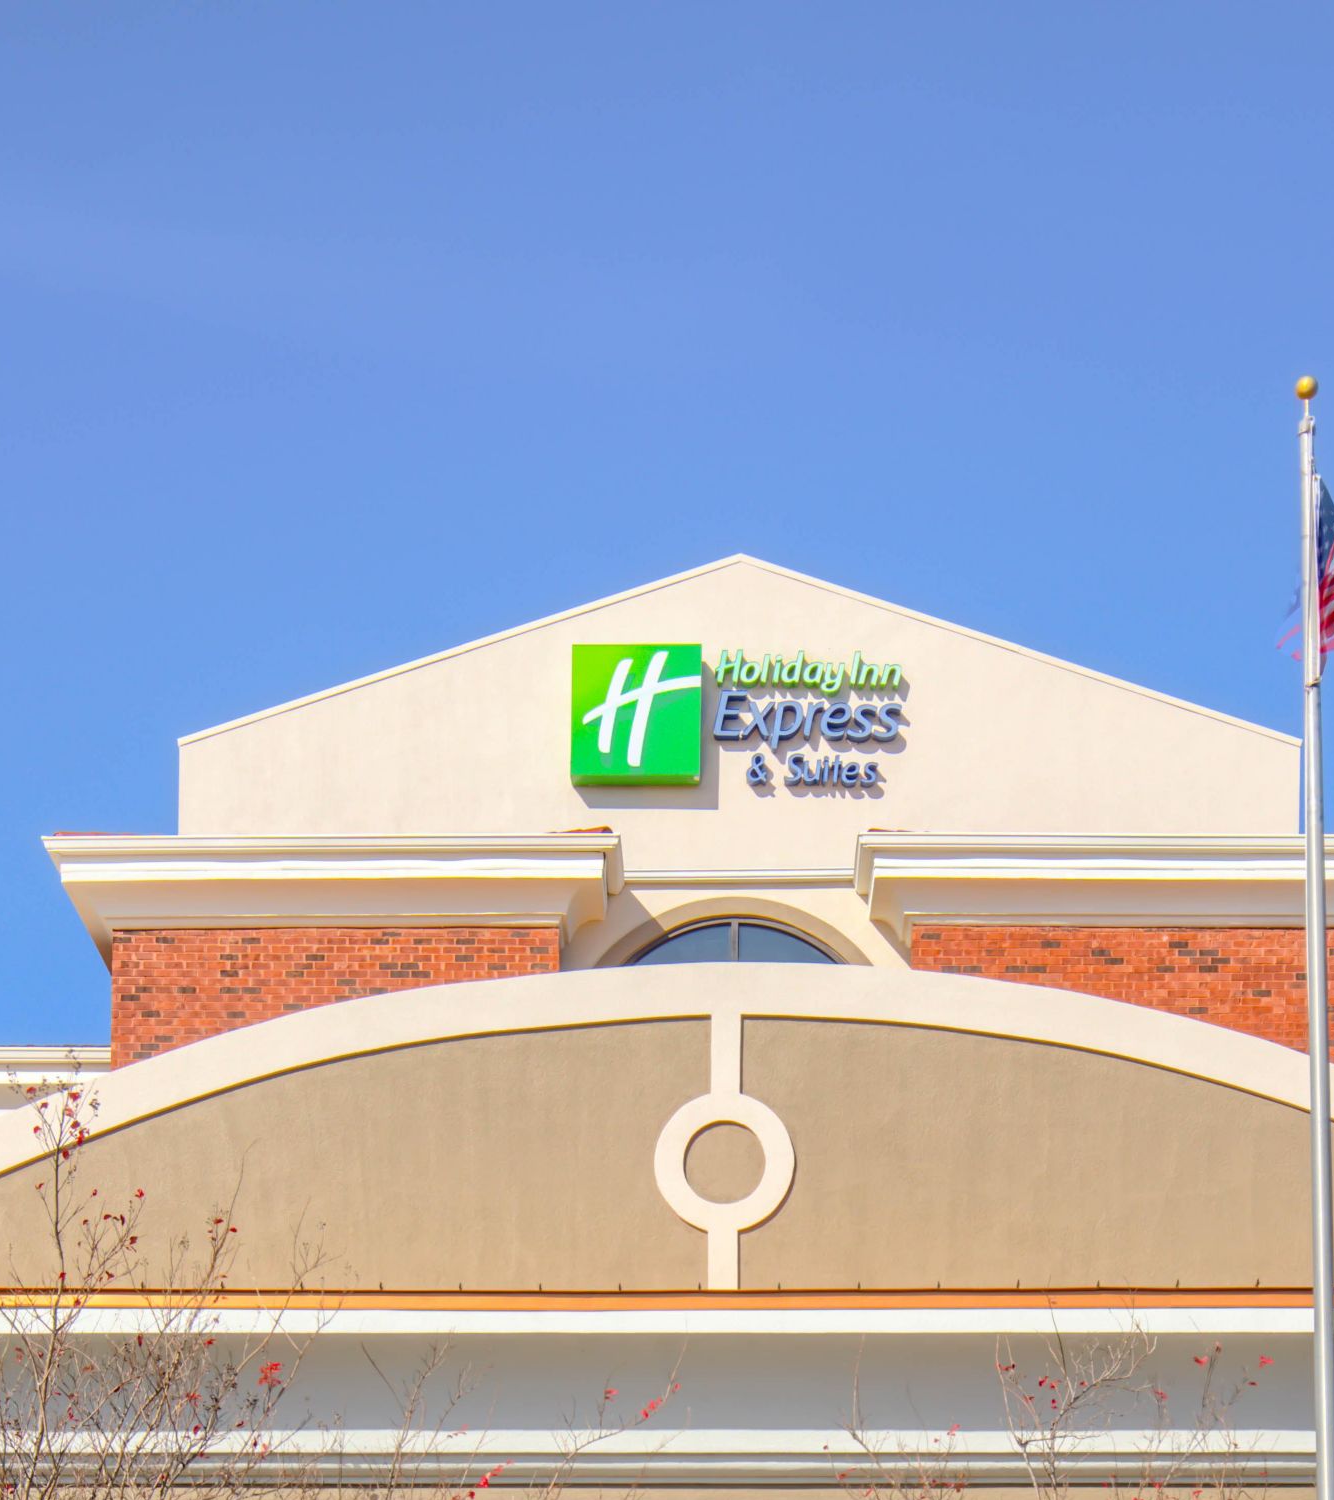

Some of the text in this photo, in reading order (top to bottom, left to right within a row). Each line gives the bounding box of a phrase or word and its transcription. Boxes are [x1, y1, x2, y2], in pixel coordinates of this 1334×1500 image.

[715, 649, 902, 697] Holiday Inn
[713, 689, 903, 753] Express
[746, 752, 879, 788] & Suites
